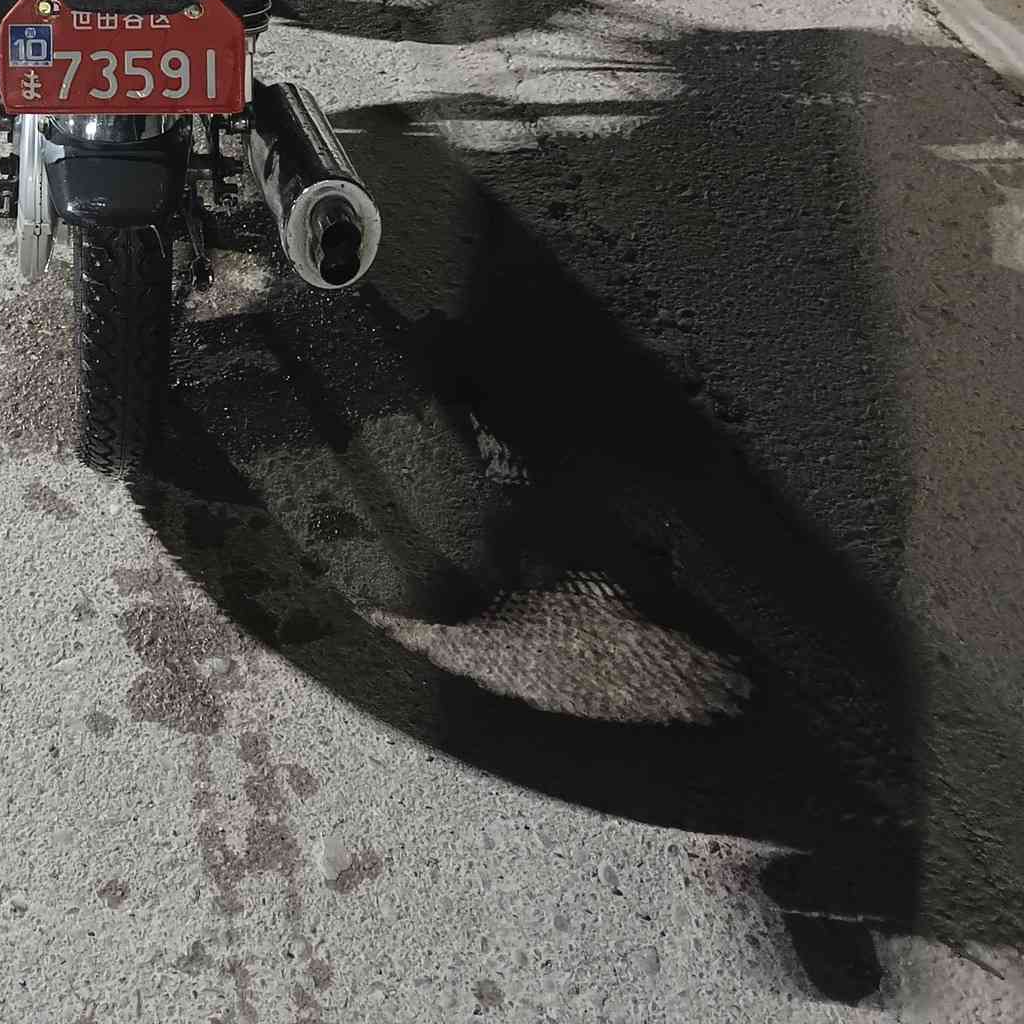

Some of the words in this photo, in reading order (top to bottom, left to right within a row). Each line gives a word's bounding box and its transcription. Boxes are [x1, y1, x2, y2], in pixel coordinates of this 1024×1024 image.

[13, 39, 48, 61] 10
[21, 69, 42, 100] ま
[53, 48, 216, 100] 73591
